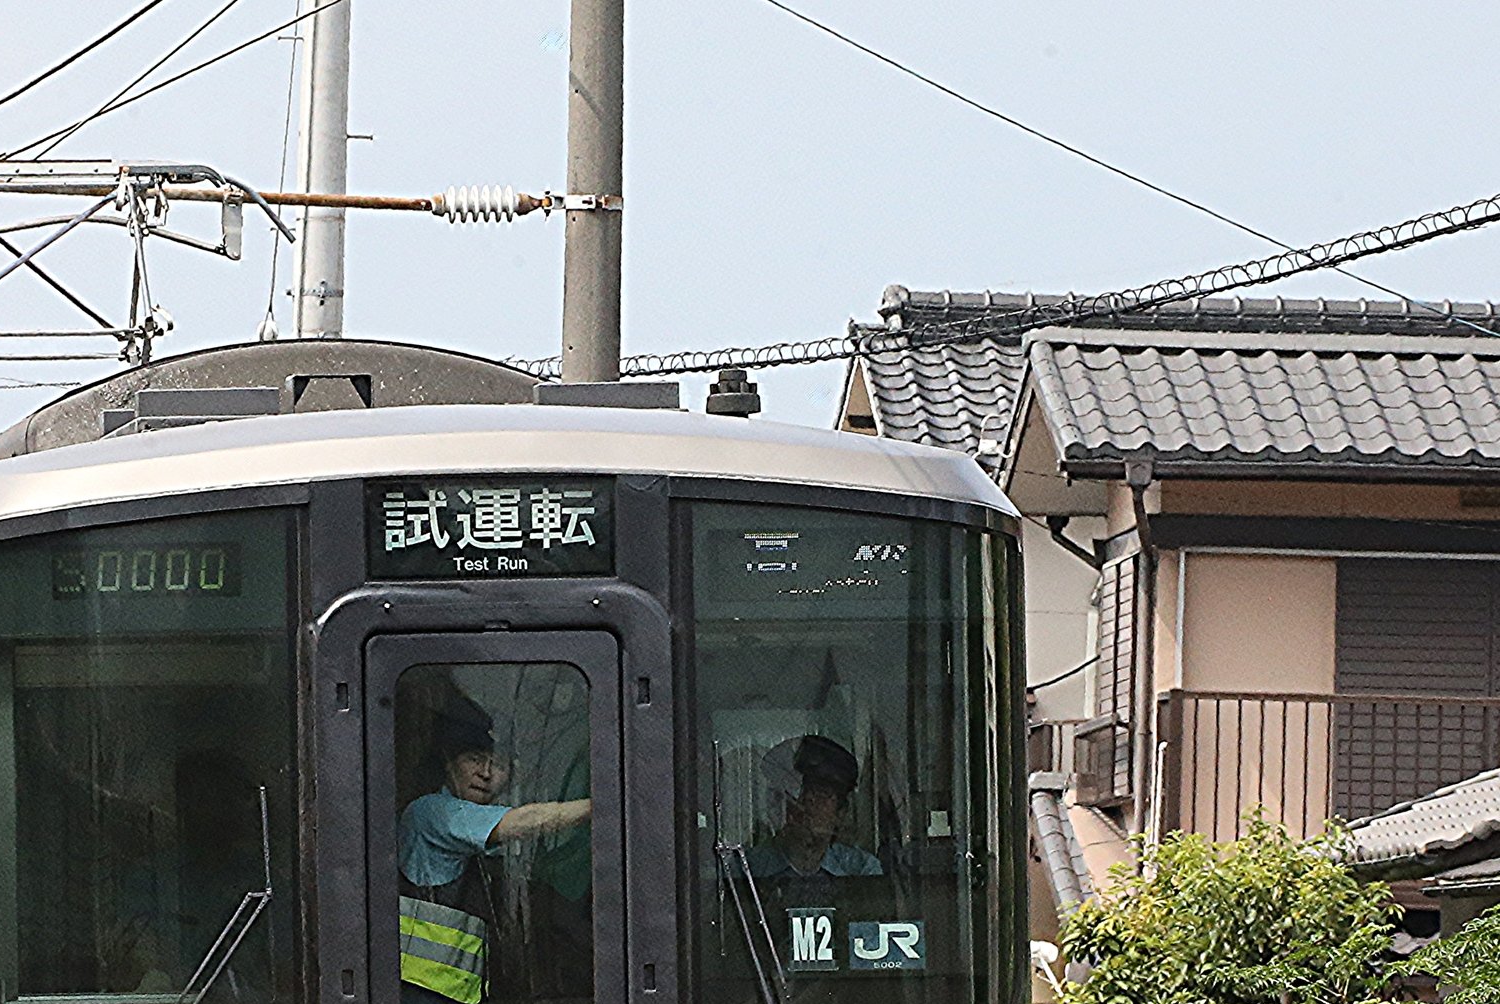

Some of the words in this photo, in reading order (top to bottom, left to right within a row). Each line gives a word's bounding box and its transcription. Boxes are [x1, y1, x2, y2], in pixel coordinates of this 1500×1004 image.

[383, 487, 596, 552] 試運転
[453, 557, 489, 571] Test
[498, 556, 528, 571] Run
[792, 915, 833, 961] M2
[854, 923, 921, 960] JR
[873, 961, 902, 969] 5002
